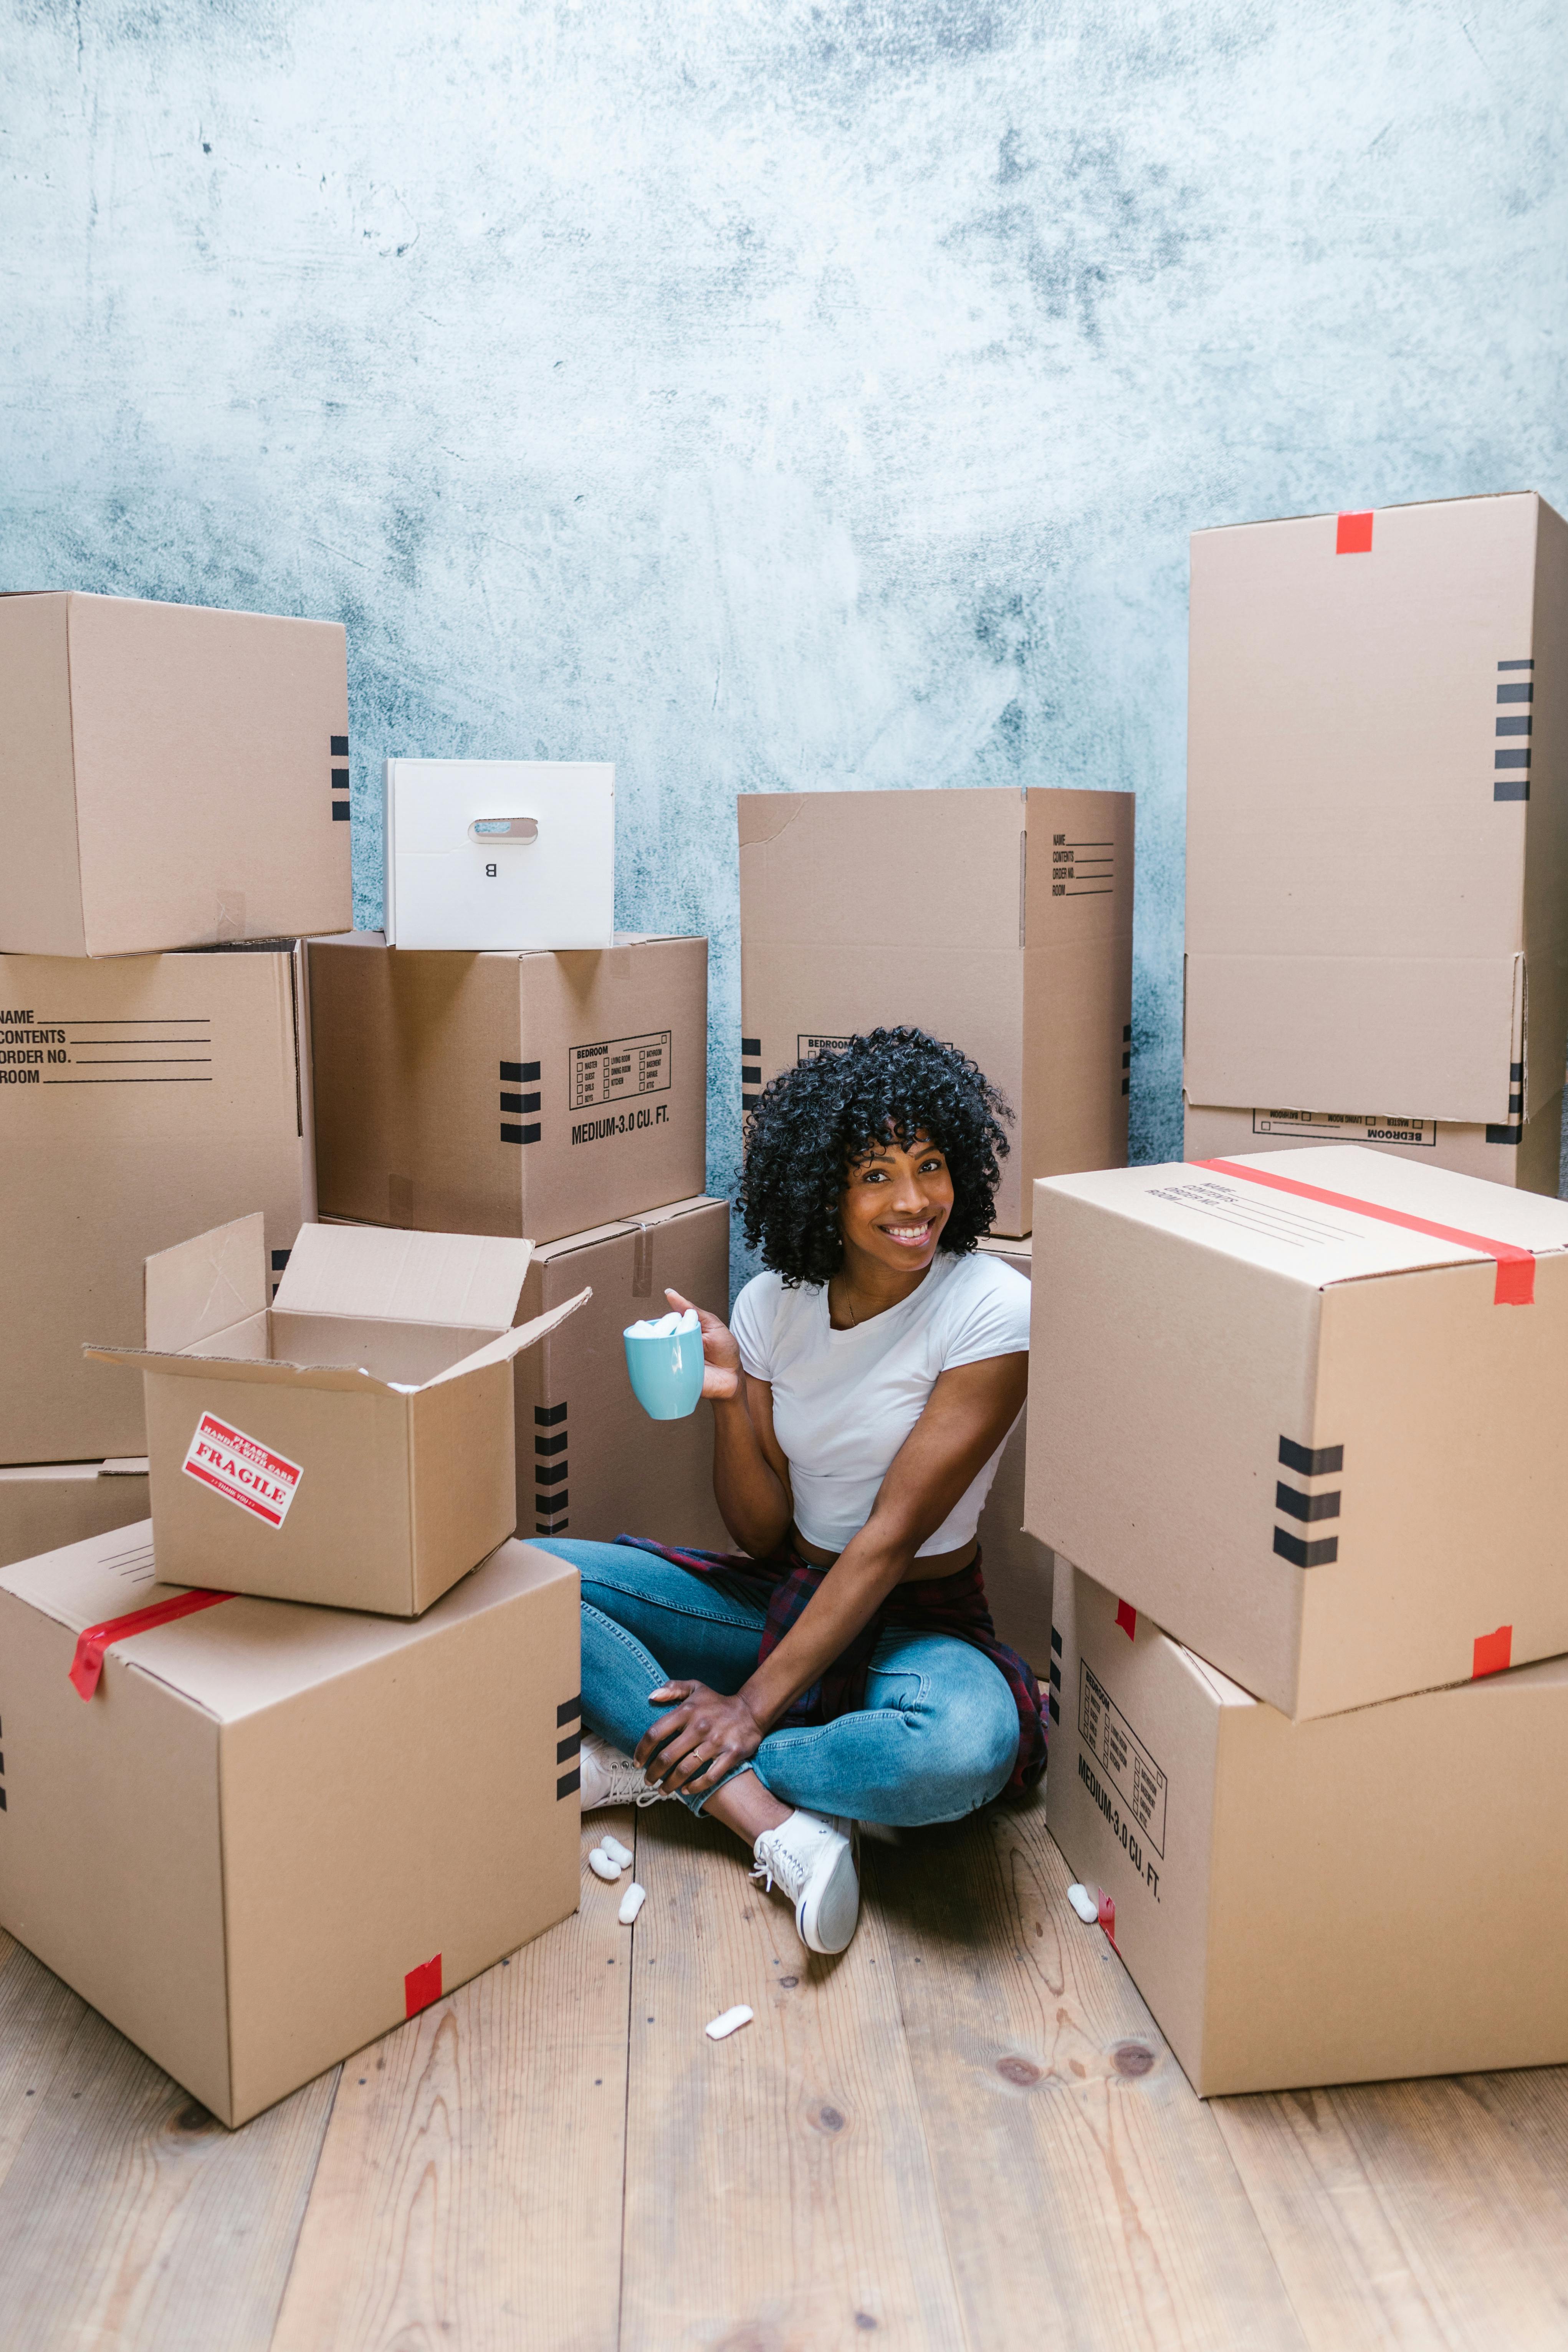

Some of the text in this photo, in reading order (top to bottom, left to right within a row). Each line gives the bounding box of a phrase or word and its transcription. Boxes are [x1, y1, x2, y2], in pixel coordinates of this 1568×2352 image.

[1053, 834, 1065, 846] NAME
[1053, 851, 1074, 863] CONTENTS
[486, 864, 496, 877] B
[1053, 868, 1067, 880] ORDER
[1052, 885, 1065, 896] ROOM
[0, 1049, 71, 1064] ORDER NO.
[577, 1045, 608, 1059] BEDROOM
[647, 1049, 662, 1058] BATHROOM
[585, 1061, 597, 1070] MASTER
[611, 1054, 630, 1065] LIVING ROOM
[647, 1059, 661, 1068] BASEMENT
[622, 1065, 631, 1073] ROOM
[647, 1070, 658, 1078] GARAGE
[0, 1070, 40, 1083] ROOM
[585, 1072, 595, 1081] GUEST
[611, 1077, 624, 1086] KITCHEN
[585, 1083, 594, 1092] GIRLS
[585, 1095, 593, 1103] BOYS
[1270, 1111, 1298, 1120] BATHROOM
[1328, 1114, 1361, 1124] LIVING ROOM
[572, 1105, 669, 1145] MEDIUM-3.0 CU. FT.
[1387, 1118, 1409, 1127] MASTER
[1368, 1129, 1422, 1141] BEDROOM
[1164, 1187, 1203, 1199] ORDER
[1183, 1185, 1239, 1202] CONTENTS
[1200, 1183, 1236, 1193] NAME
[1145, 1190, 1183, 1201] ROOM
[203, 1425, 294, 1482] HANDLE WITH CARE
[233, 1435, 268, 1460] PLEASE
[195, 1442, 286, 1505] FRAGILE
[218, 1482, 249, 1504] THANK YOU
[1086, 1670, 1110, 1712] BEDROOM
[1078, 1753, 1160, 1904] MEDIUM-3.0 CU. FT.
